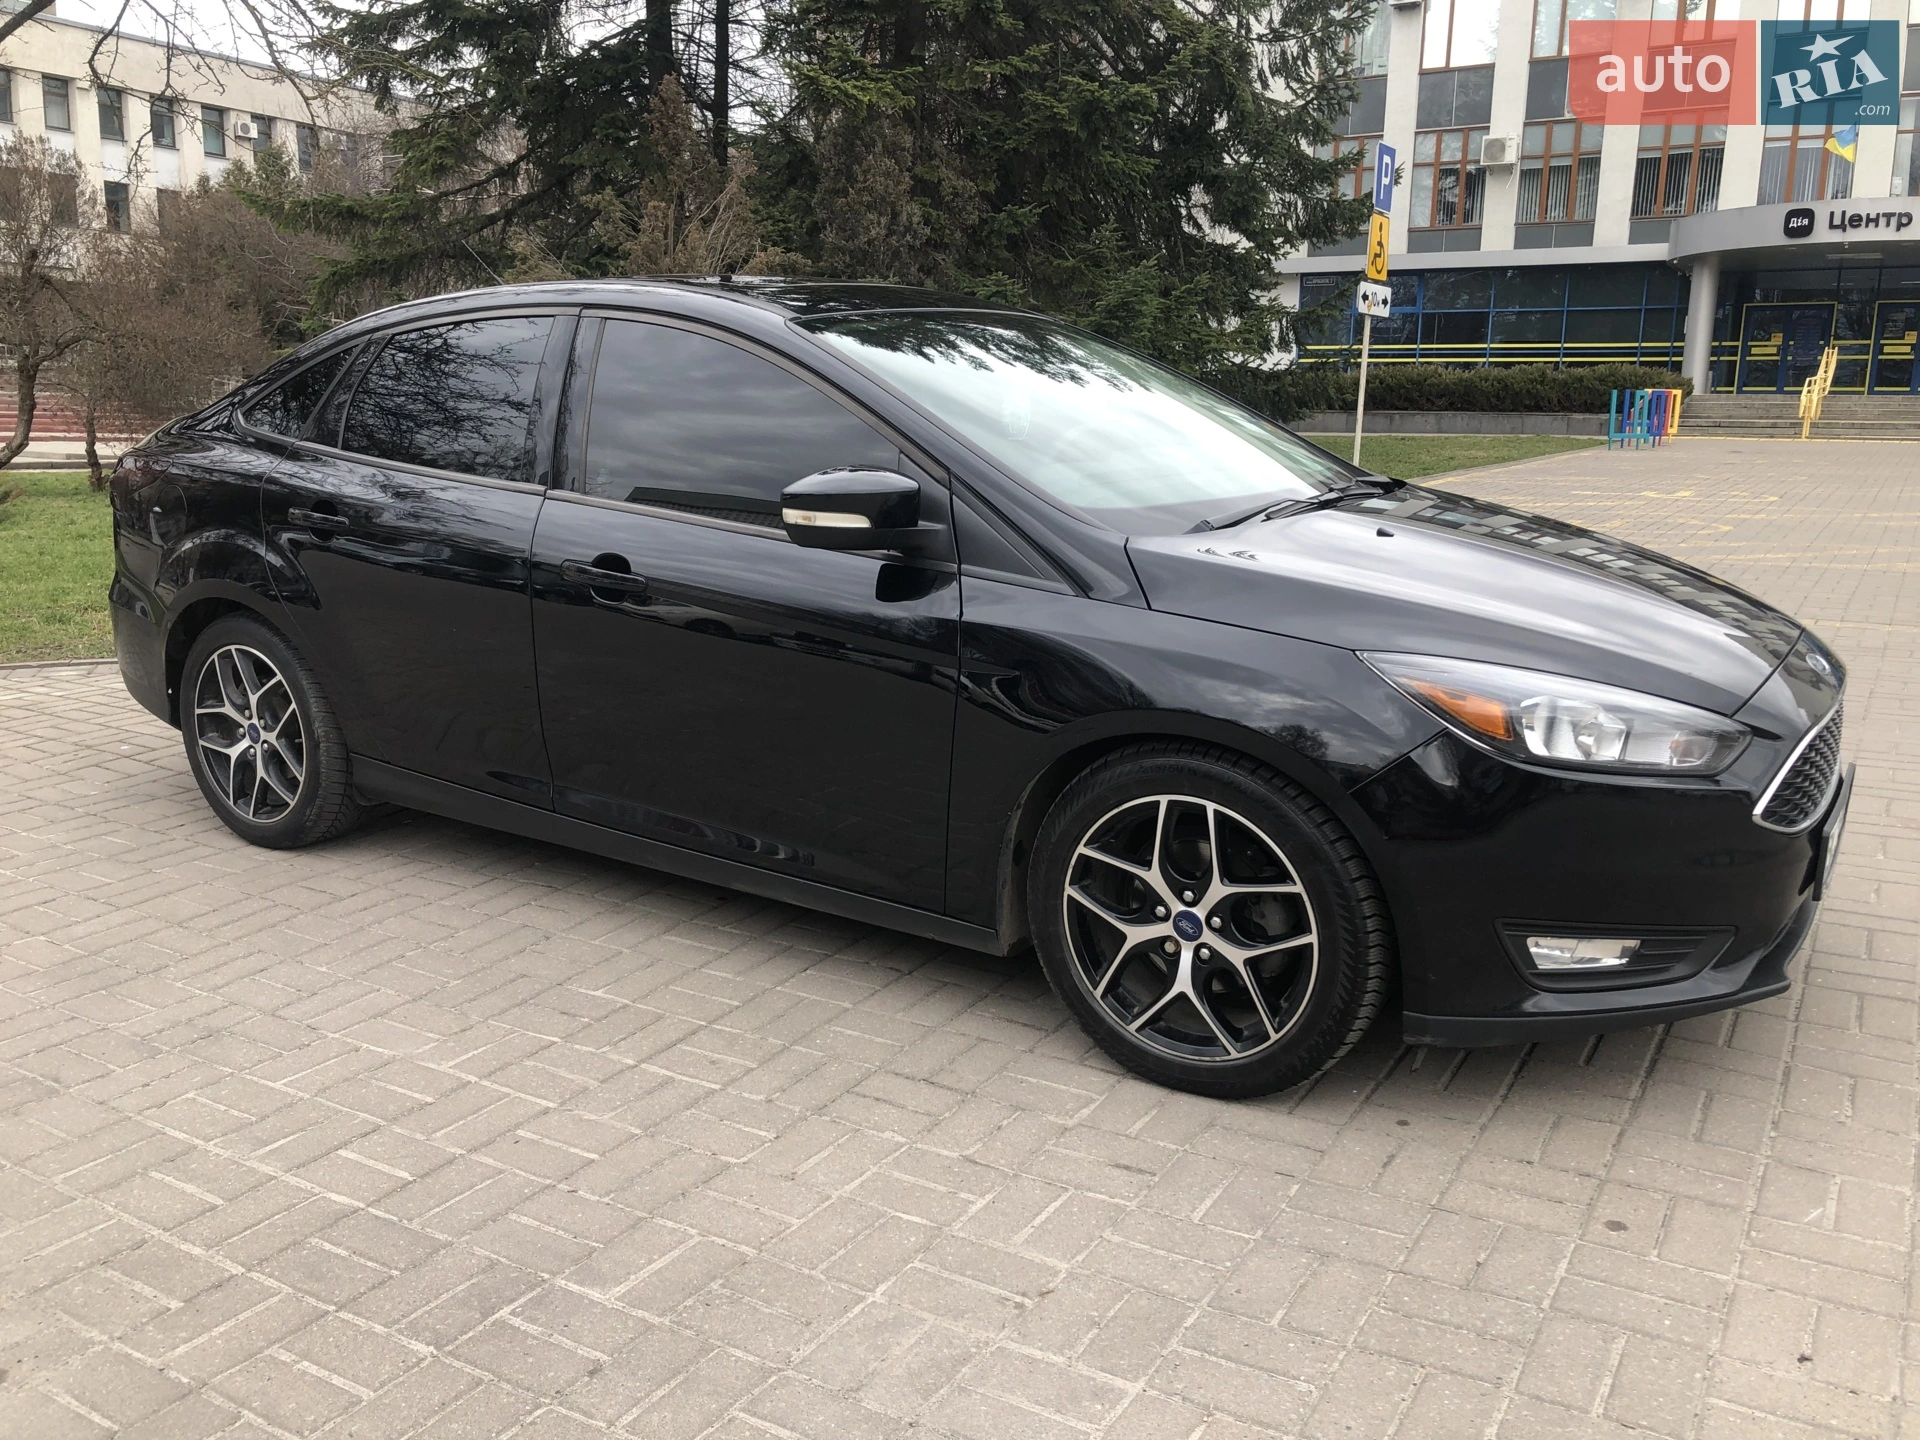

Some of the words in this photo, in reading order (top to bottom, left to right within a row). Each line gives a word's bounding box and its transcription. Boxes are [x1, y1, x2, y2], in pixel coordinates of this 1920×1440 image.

[1380, 154, 1391, 200] P
[1788, 216, 1809, 228] Дія
[1828, 210, 1913, 233] Центр
